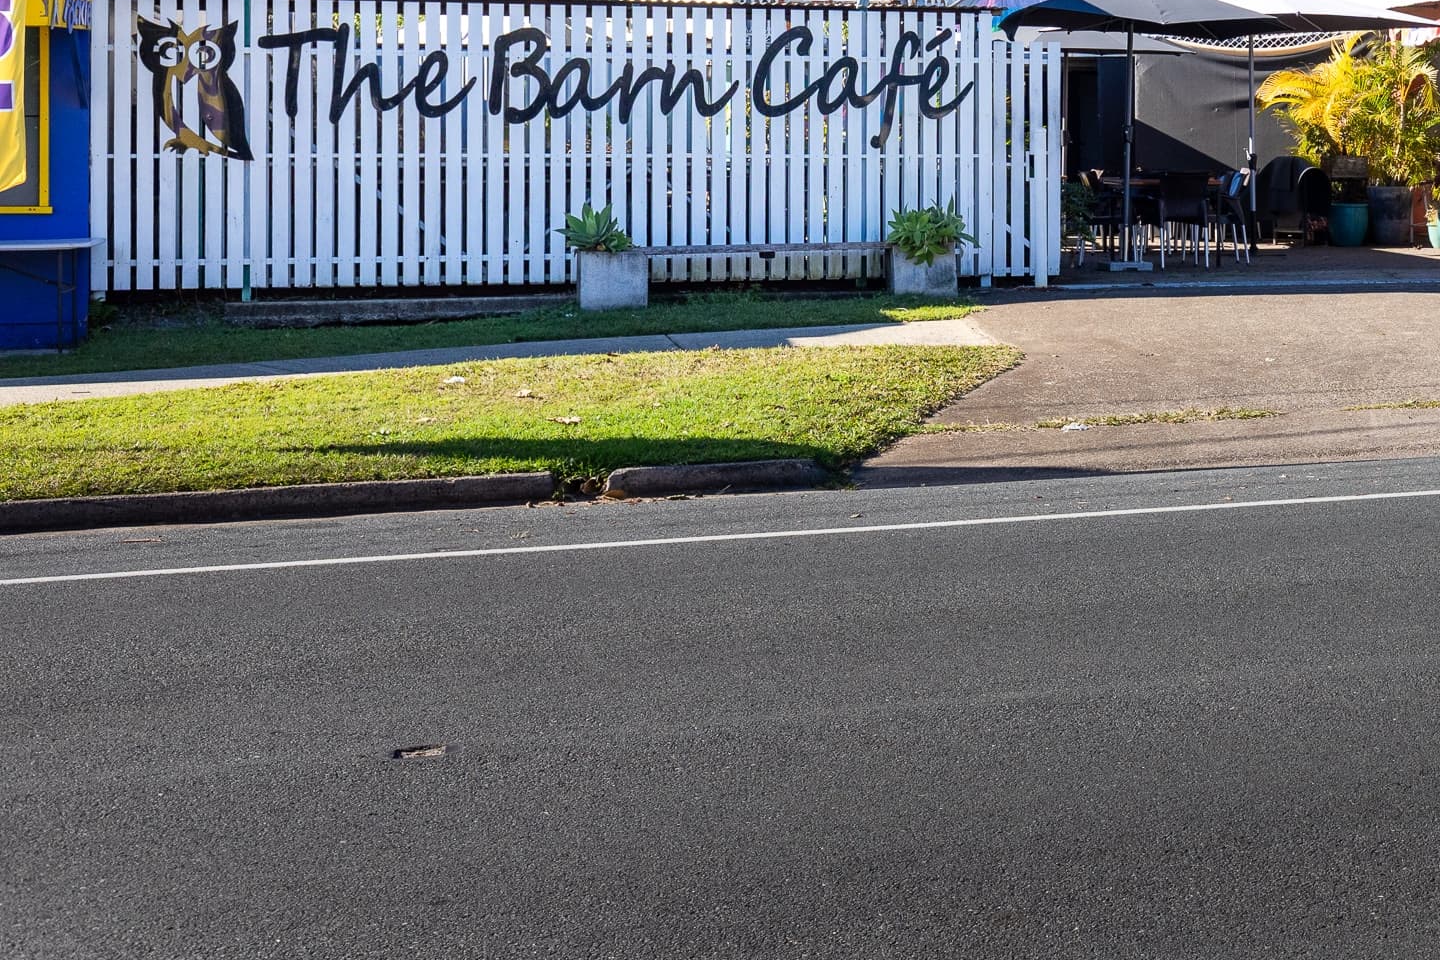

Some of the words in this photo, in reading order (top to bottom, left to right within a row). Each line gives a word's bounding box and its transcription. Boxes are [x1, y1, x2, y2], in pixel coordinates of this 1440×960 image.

[257, 23, 476, 125] The
[488, 26, 740, 125] Barn
[752, 25, 975, 150] Café
